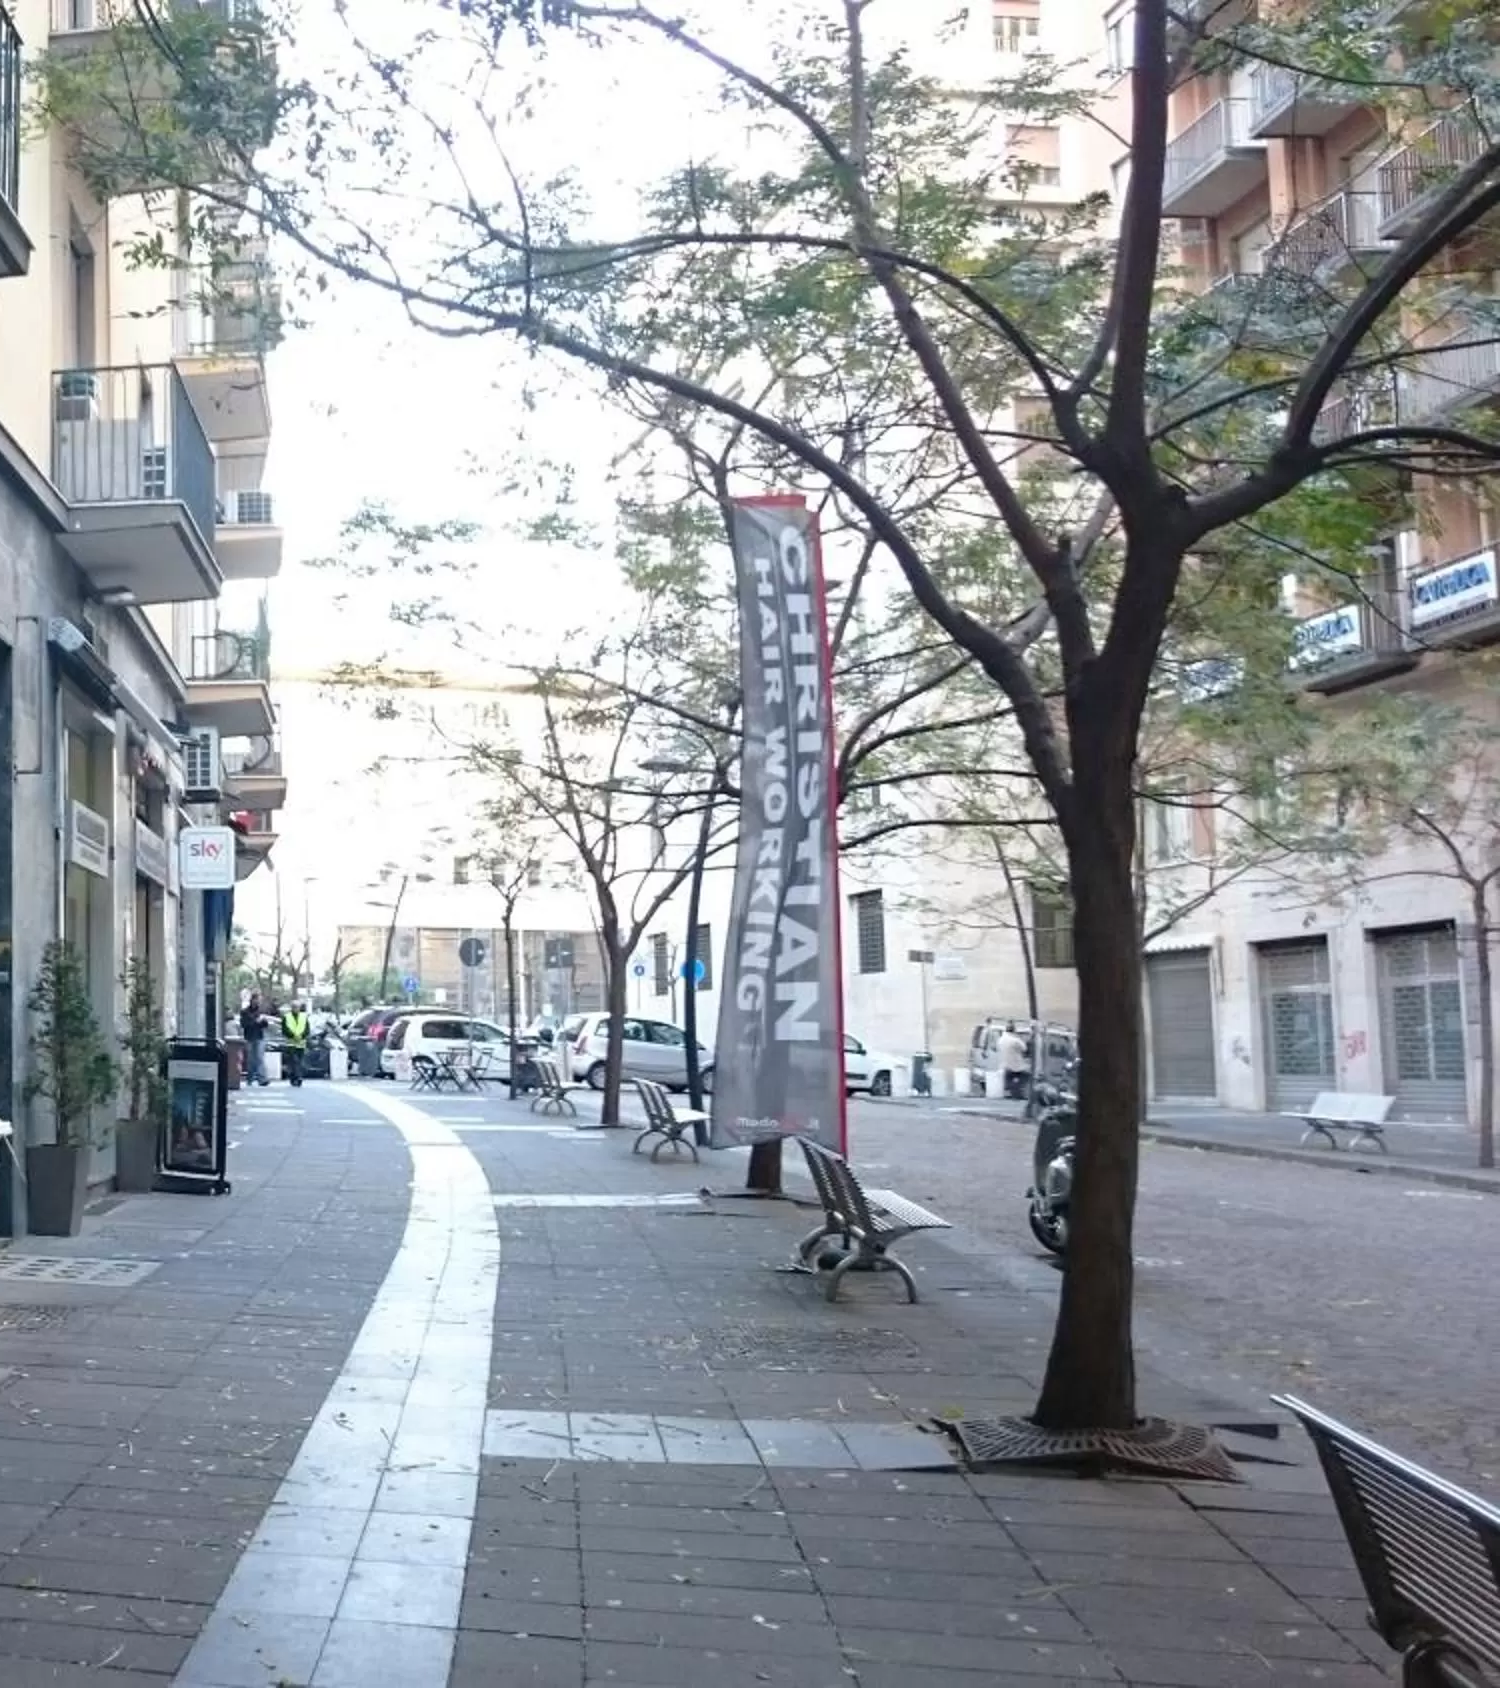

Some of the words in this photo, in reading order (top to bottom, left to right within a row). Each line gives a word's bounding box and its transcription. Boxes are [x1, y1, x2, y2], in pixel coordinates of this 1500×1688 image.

[754, 558, 783, 706] HAIR
[189, 838, 223, 861] sky
[736, 726, 788, 1012] WORKING
[774, 526, 822, 1042] CHRISTIAN
